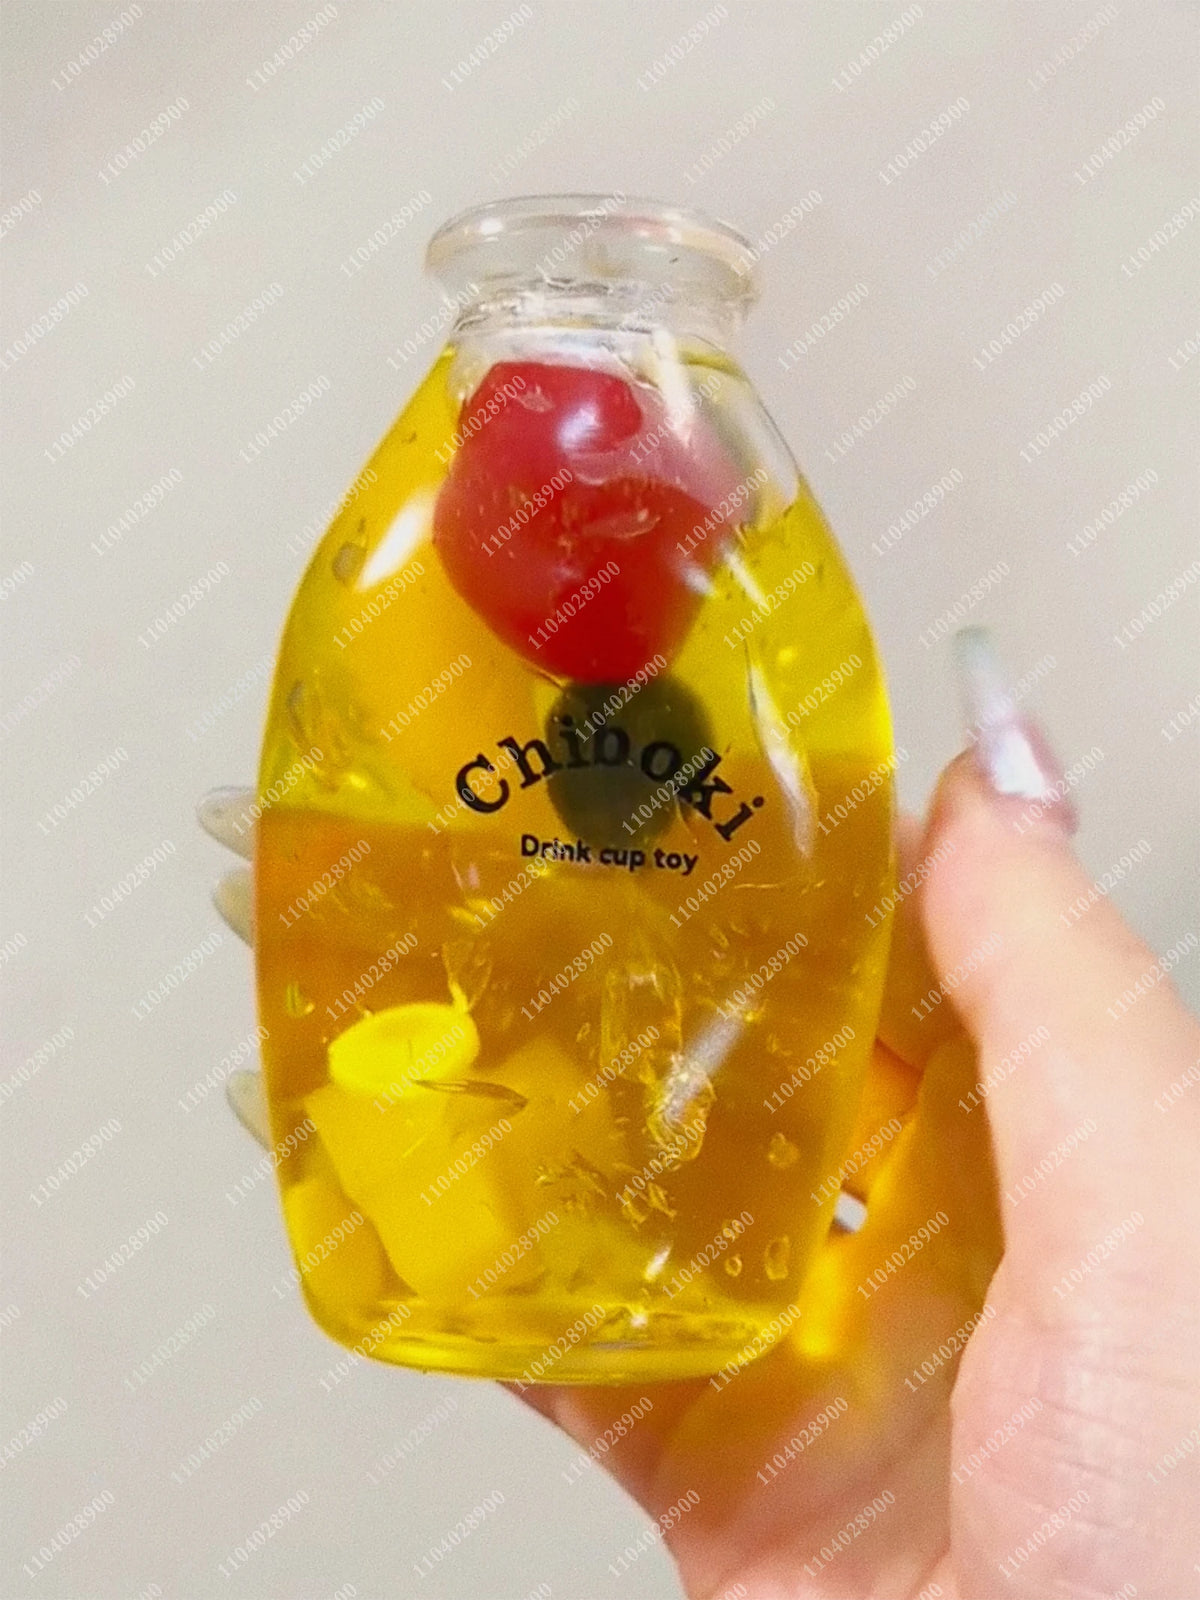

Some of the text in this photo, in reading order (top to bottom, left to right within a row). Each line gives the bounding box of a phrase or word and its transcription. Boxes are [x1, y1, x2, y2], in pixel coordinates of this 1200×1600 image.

[456, 711, 764, 842] Chiboki
[521, 834, 699, 876] Drink cup toy
